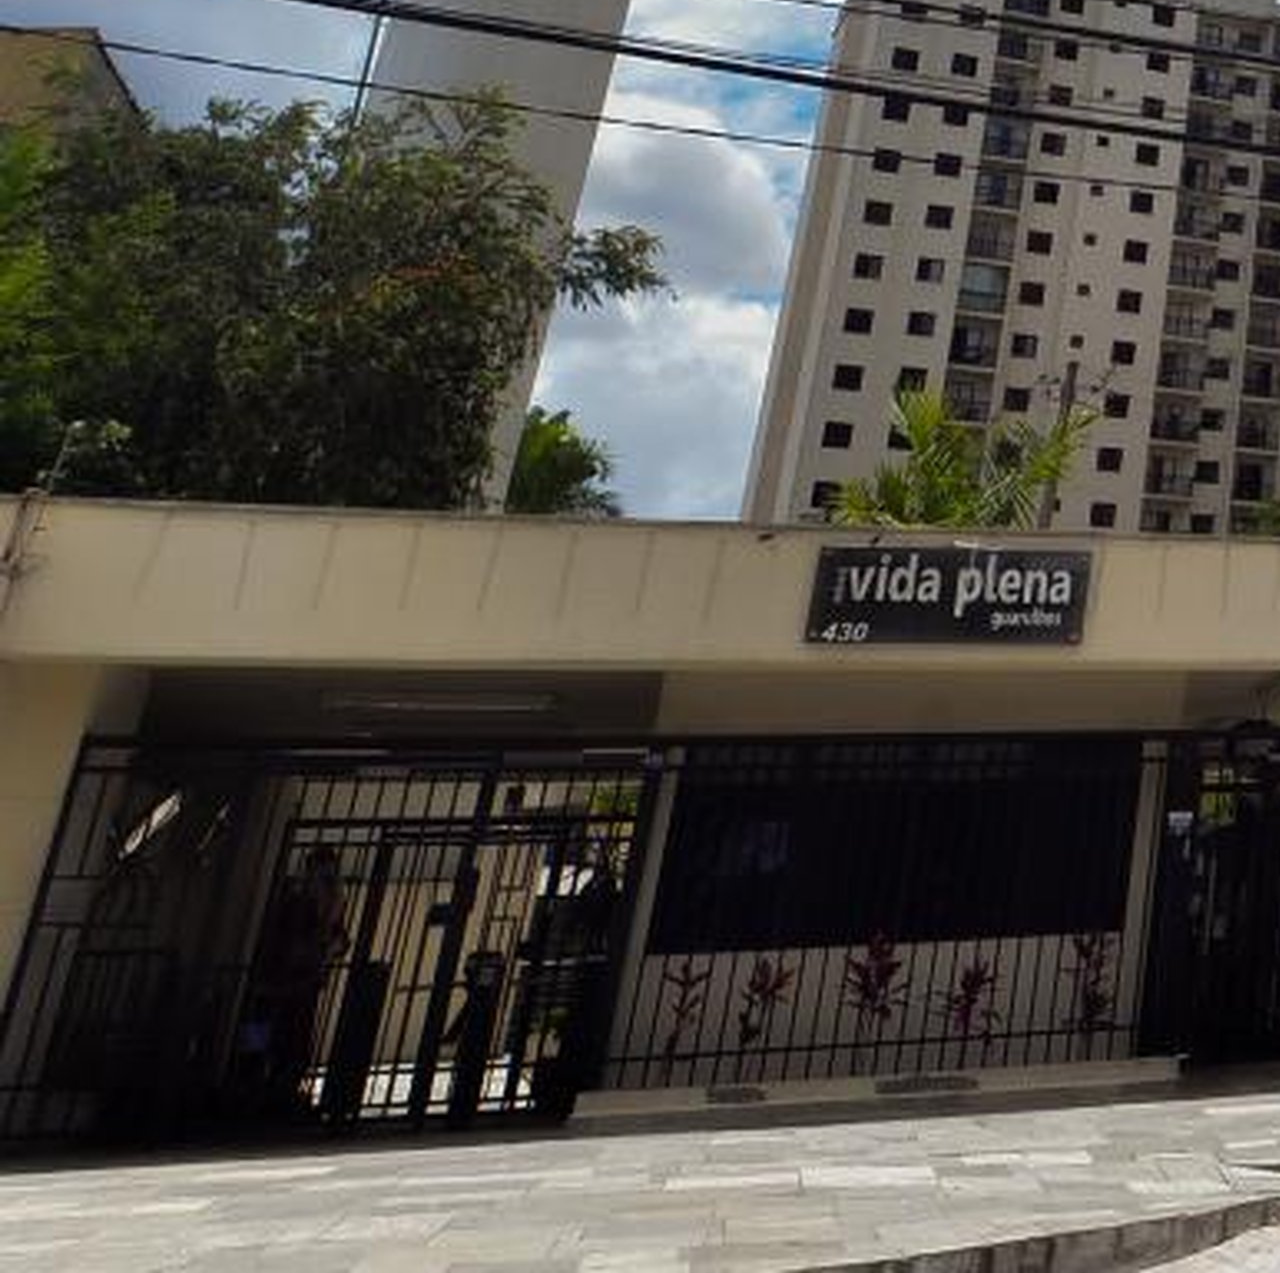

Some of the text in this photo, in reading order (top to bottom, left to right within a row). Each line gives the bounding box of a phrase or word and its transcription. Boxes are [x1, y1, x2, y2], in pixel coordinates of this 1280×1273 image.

[850, 554, 942, 603] vida
[953, 554, 1071, 618] plena
[821, 623, 868, 641] 430
